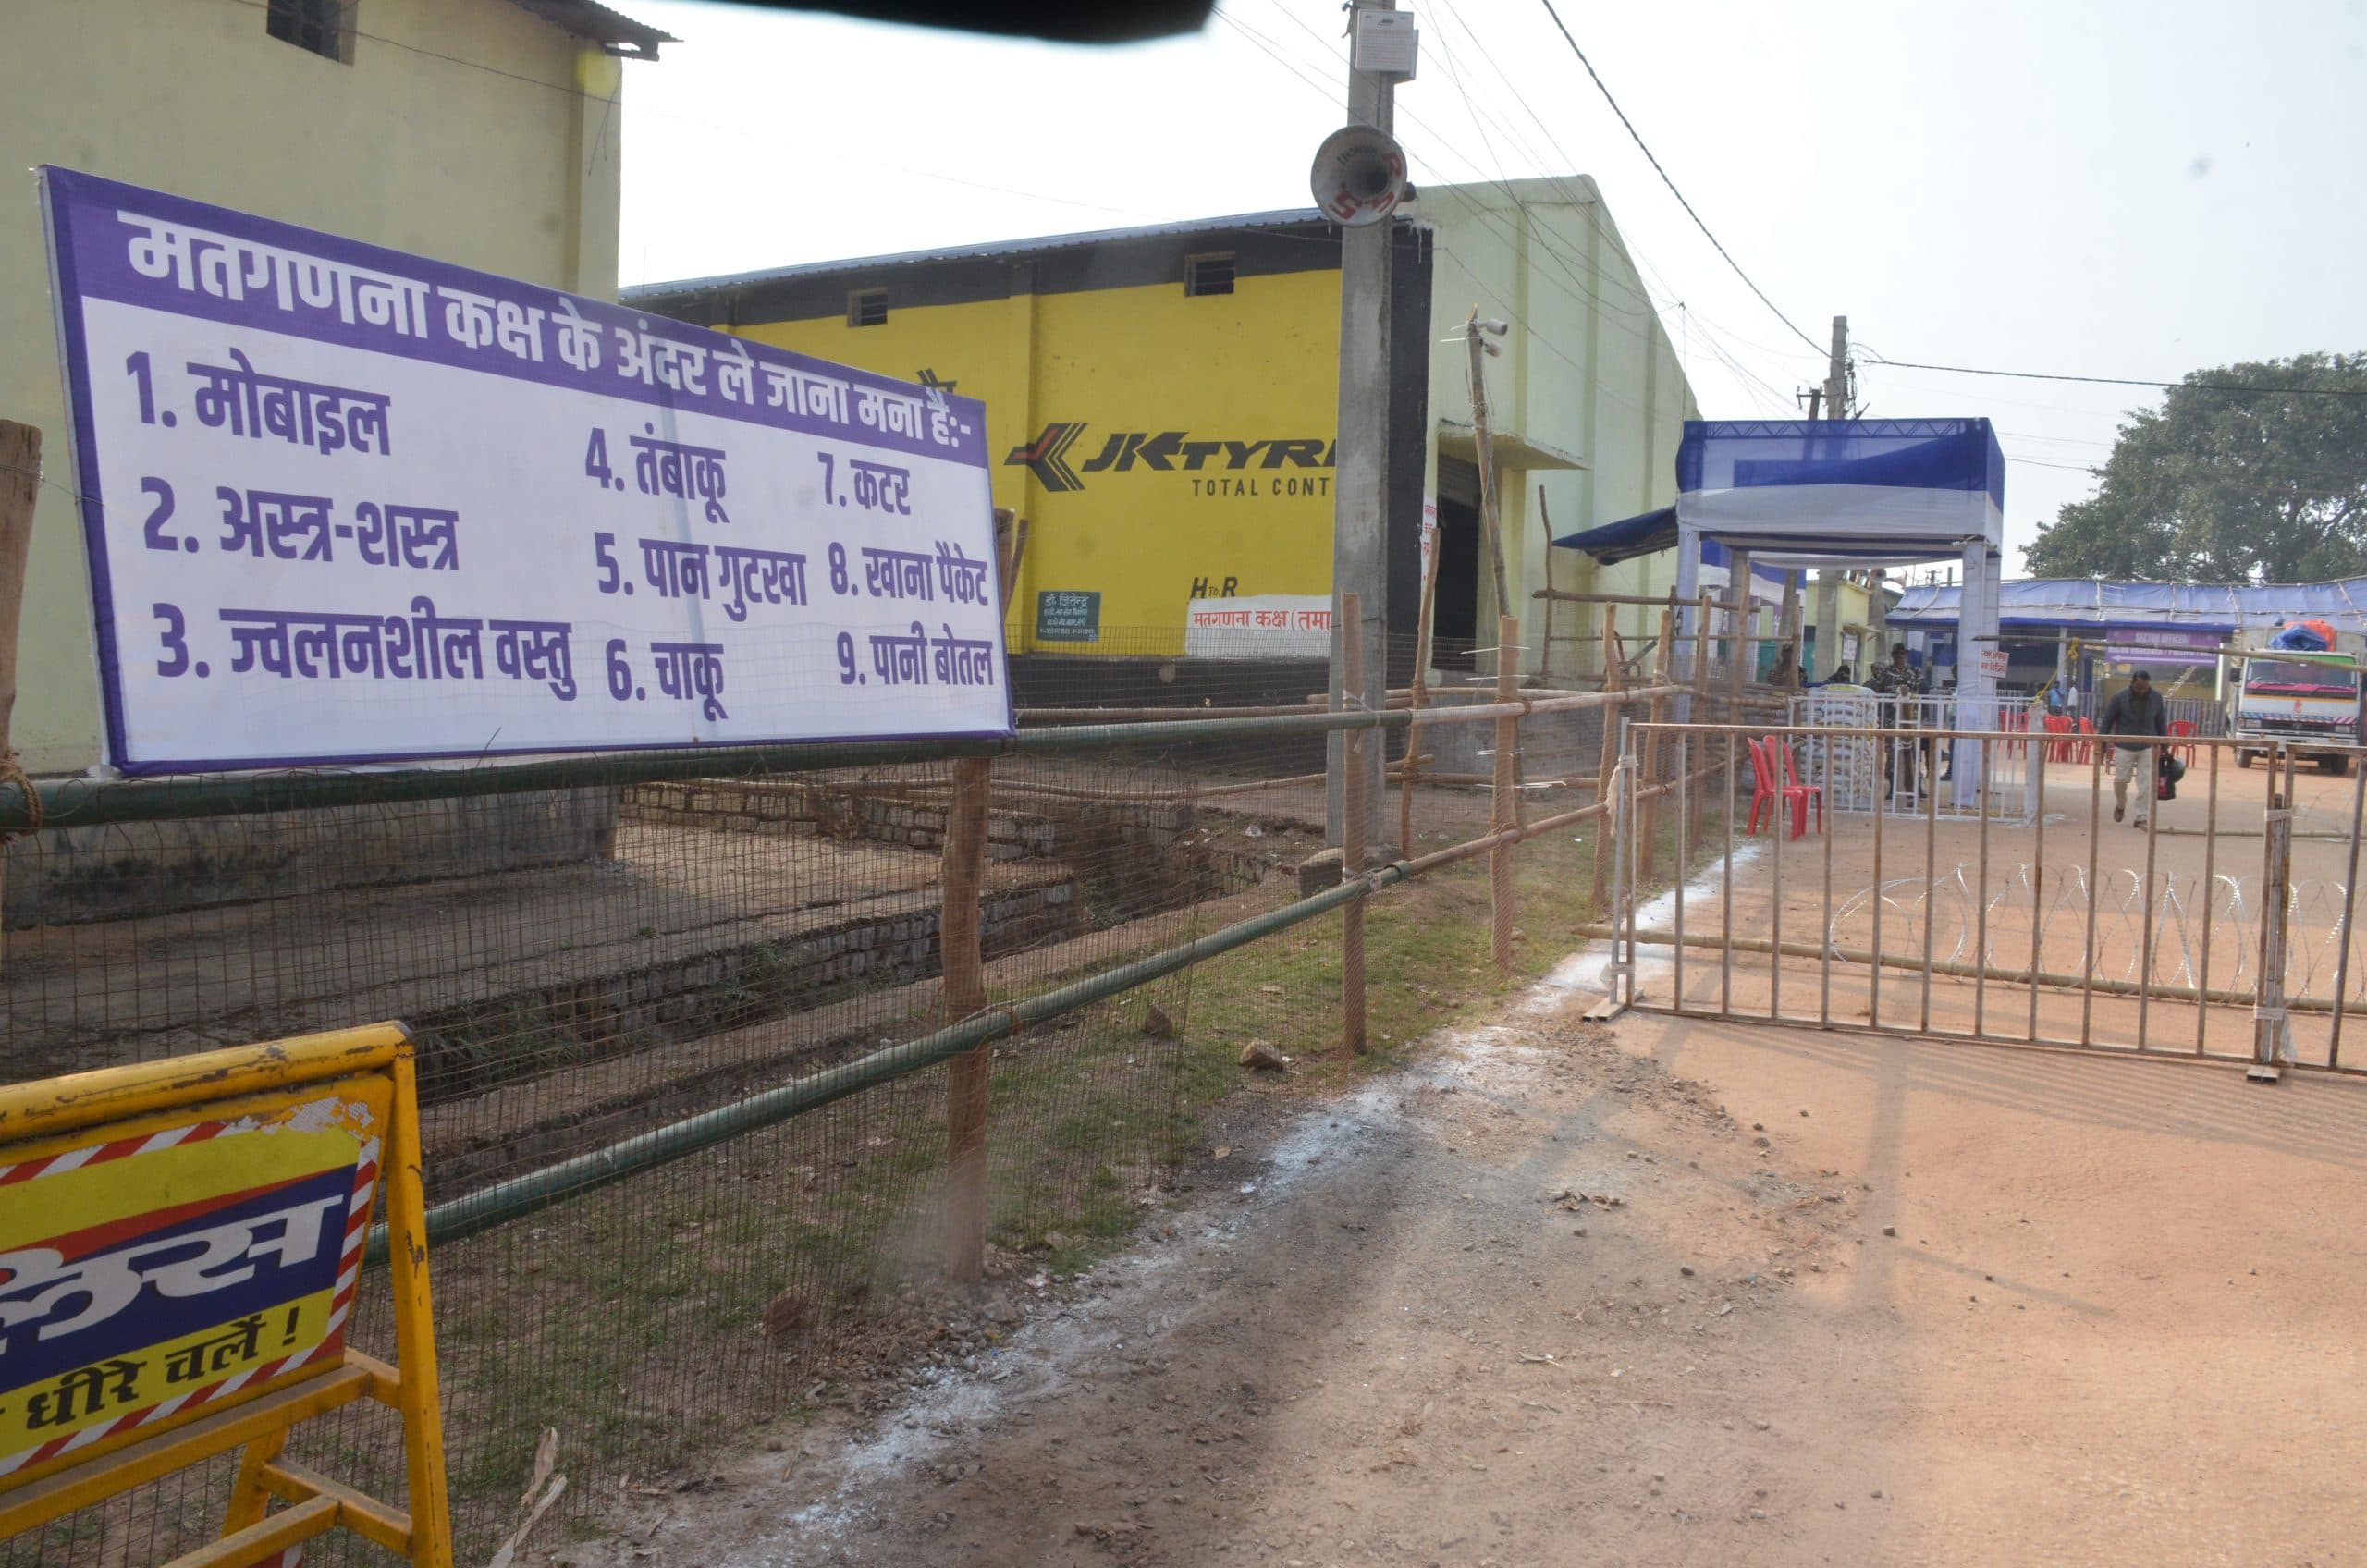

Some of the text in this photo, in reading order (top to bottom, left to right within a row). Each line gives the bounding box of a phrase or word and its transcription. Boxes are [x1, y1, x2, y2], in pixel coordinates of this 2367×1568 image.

[117, 209, 432, 339] मतगणना
[437, 284, 547, 363] कक्ष
[552, 299, 603, 372] के
[615, 319, 708, 396] अंदर
[713, 339, 755, 405] ले
[759, 363, 850, 425] जाना
[858, 384, 924, 441] मना
[127, 347, 392, 457] 1. मोबाइल
[585, 423, 730, 523] 4. तंबाकू
[818, 452, 911, 515] 7. कटर
[1193, 479, 1258, 496] TOTAL
[141, 477, 460, 570] 2. अस्त्र-शस्त्र
[595, 533, 807, 622] 5. पान गुटखा
[828, 540, 988, 606] 8. खाना पैकेट
[1190, 577, 1208, 600] H
[1221, 577, 1238, 598] R
[153, 596, 577, 701] 3. ज्वलनशील वस्तु
[837, 621, 994, 686] 9. पानी बोतल
[1193, 611, 1252, 628] मतगणना
[1255, 611, 1289, 630] कक्ष
[607, 639, 728, 722] 6. चाकू
[165, 1313, 266, 1383] चलें
